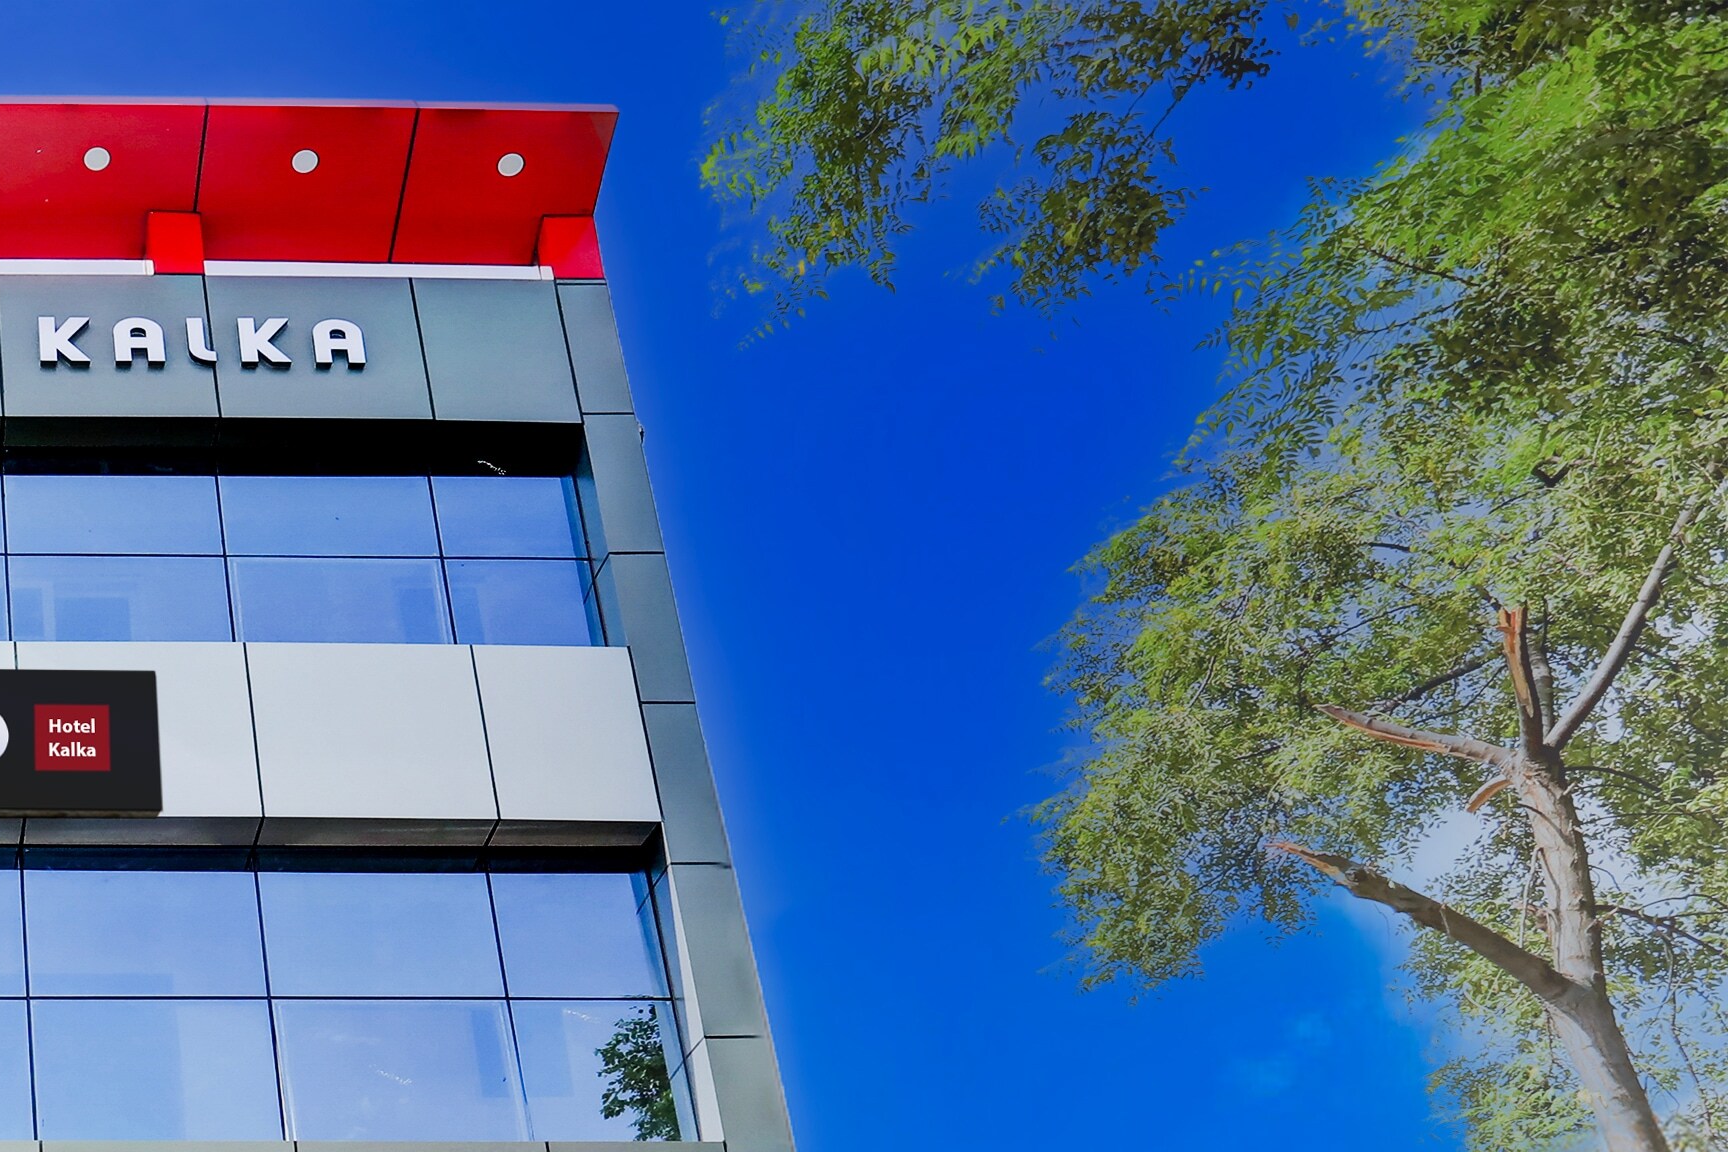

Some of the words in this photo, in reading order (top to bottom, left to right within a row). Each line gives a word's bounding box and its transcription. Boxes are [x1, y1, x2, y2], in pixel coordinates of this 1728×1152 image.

[37, 316, 368, 370] KALKA
[48, 718, 96, 734] Hotel
[48, 742, 97, 757] Kalka
